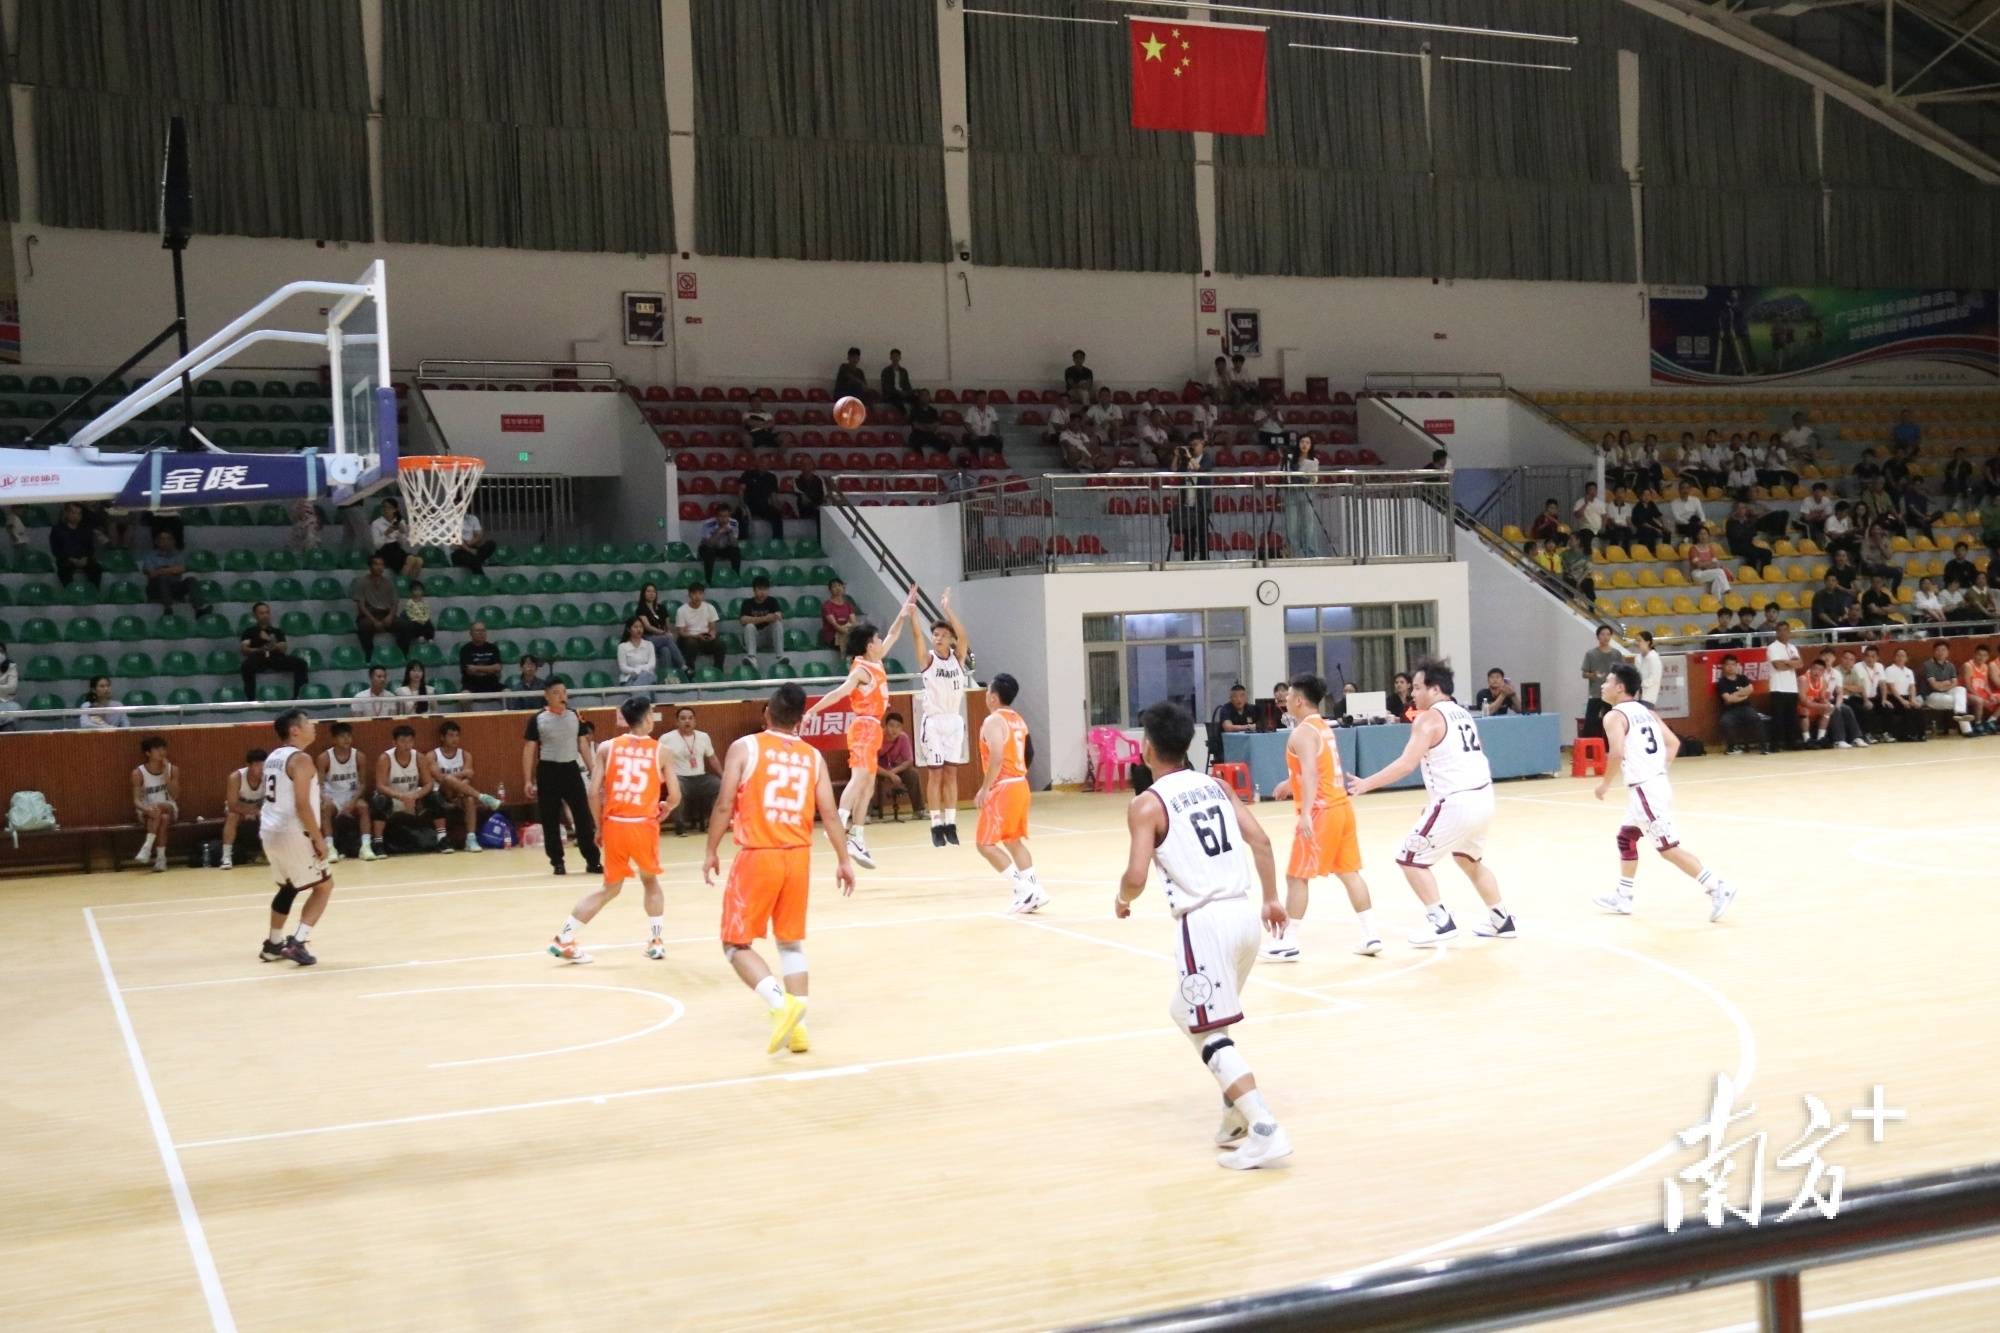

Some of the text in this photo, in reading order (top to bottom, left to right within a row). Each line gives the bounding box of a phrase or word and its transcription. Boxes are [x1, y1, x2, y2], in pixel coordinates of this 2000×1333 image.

[140, 465, 269, 496] 金陵
[1458, 723, 1481, 752] 12
[1640, 726, 1658, 755] 3
[612, 756, 653, 794] 35
[763, 763, 808, 814] 23
[1188, 804, 1233, 858] 67
